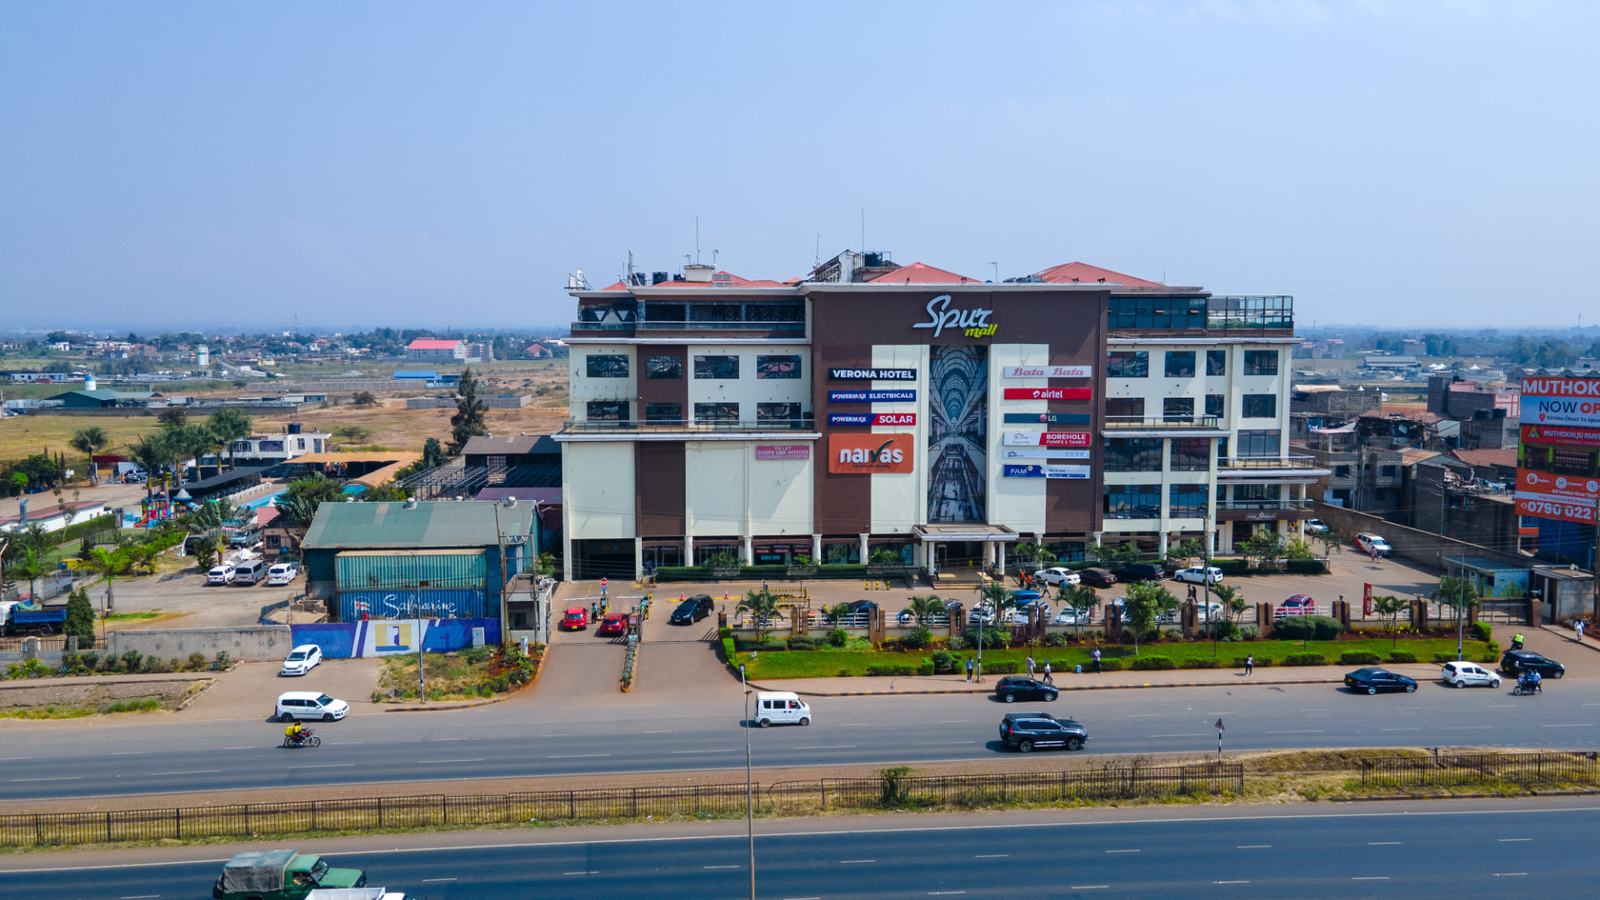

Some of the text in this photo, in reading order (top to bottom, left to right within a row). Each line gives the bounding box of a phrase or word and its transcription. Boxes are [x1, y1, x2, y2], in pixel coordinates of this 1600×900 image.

[913, 295, 993, 337] Spur
[965, 324, 998, 337] mall
[833, 370, 914, 379] VERONA HOTEL
[1013, 368, 1045, 376] Bata
[1052, 367, 1084, 376] Bata
[1041, 389, 1063, 399] airtel
[1539, 401, 1577, 413] NOW
[879, 415, 913, 424] SOLAR
[1527, 501, 1562, 516] 0790
[1565, 506, 1592, 520] 022
